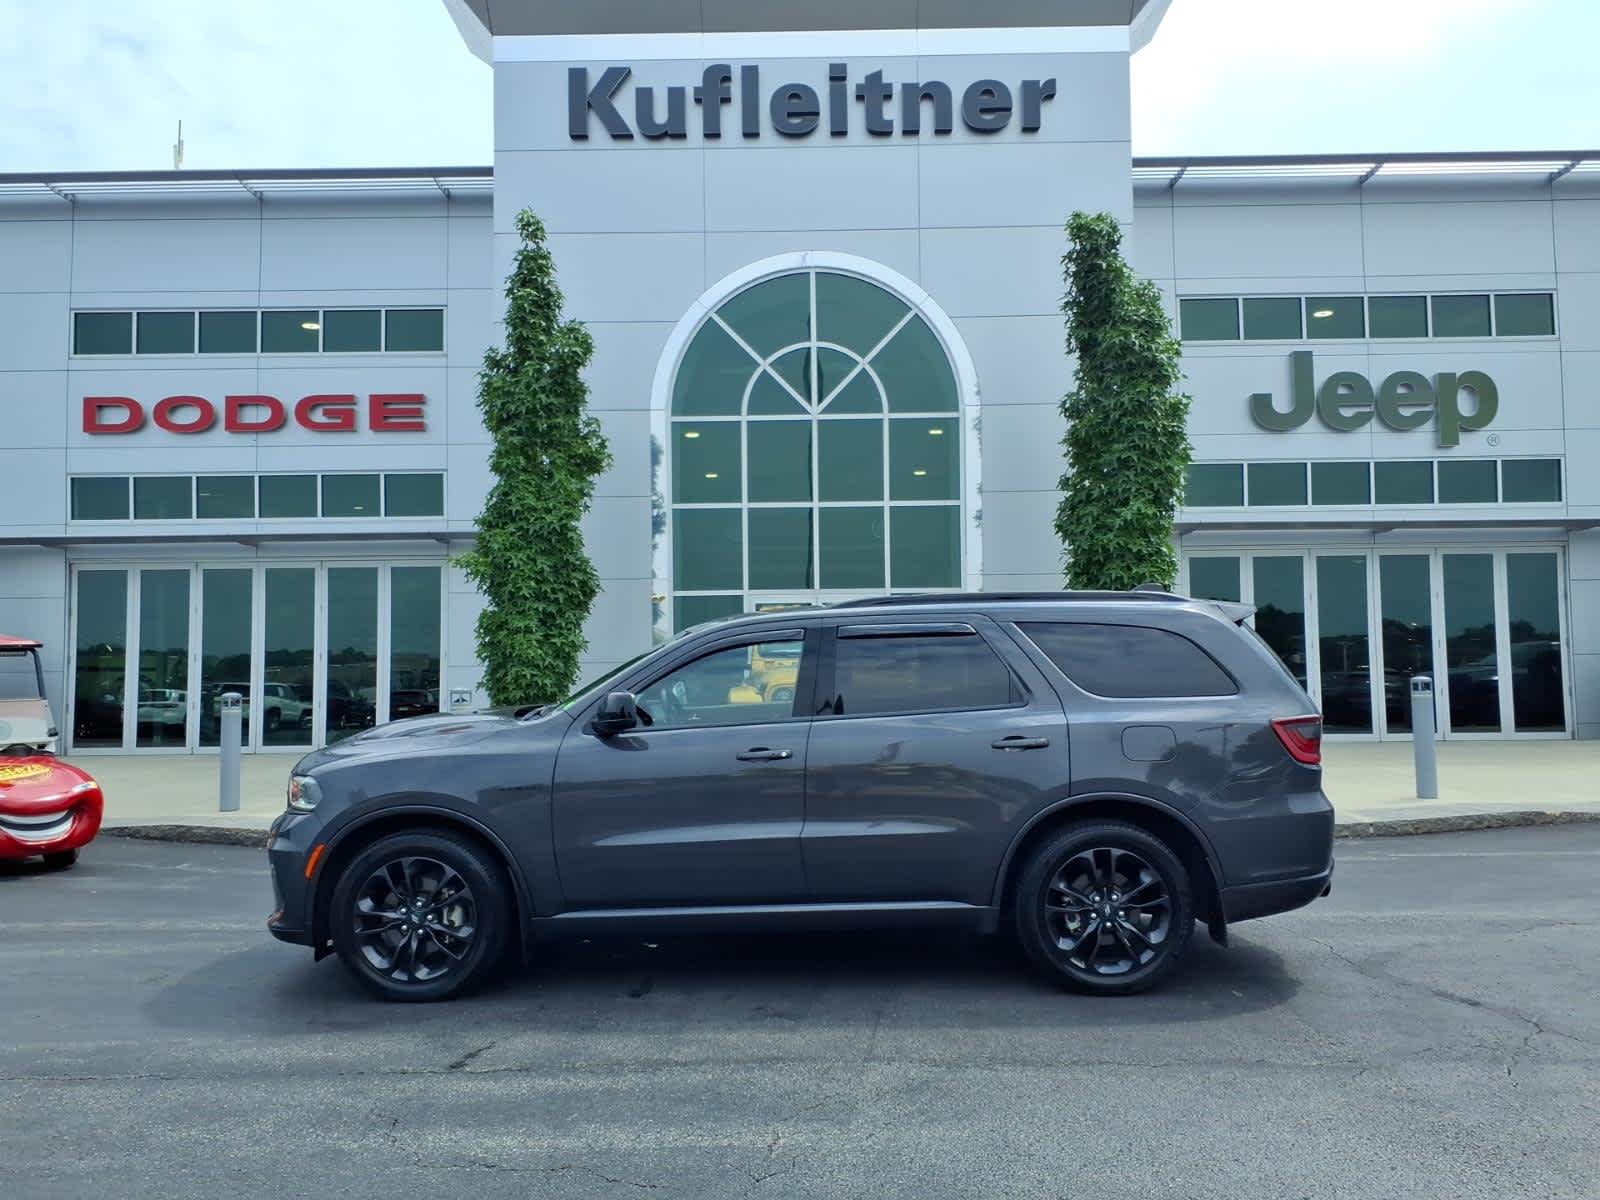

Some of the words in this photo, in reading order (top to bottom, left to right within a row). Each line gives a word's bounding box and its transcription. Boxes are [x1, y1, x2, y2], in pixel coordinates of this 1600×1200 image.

[568, 63, 1057, 141] Kufleitner
[83, 394, 427, 434] DODGE
[1249, 350, 1499, 449] Jeep
